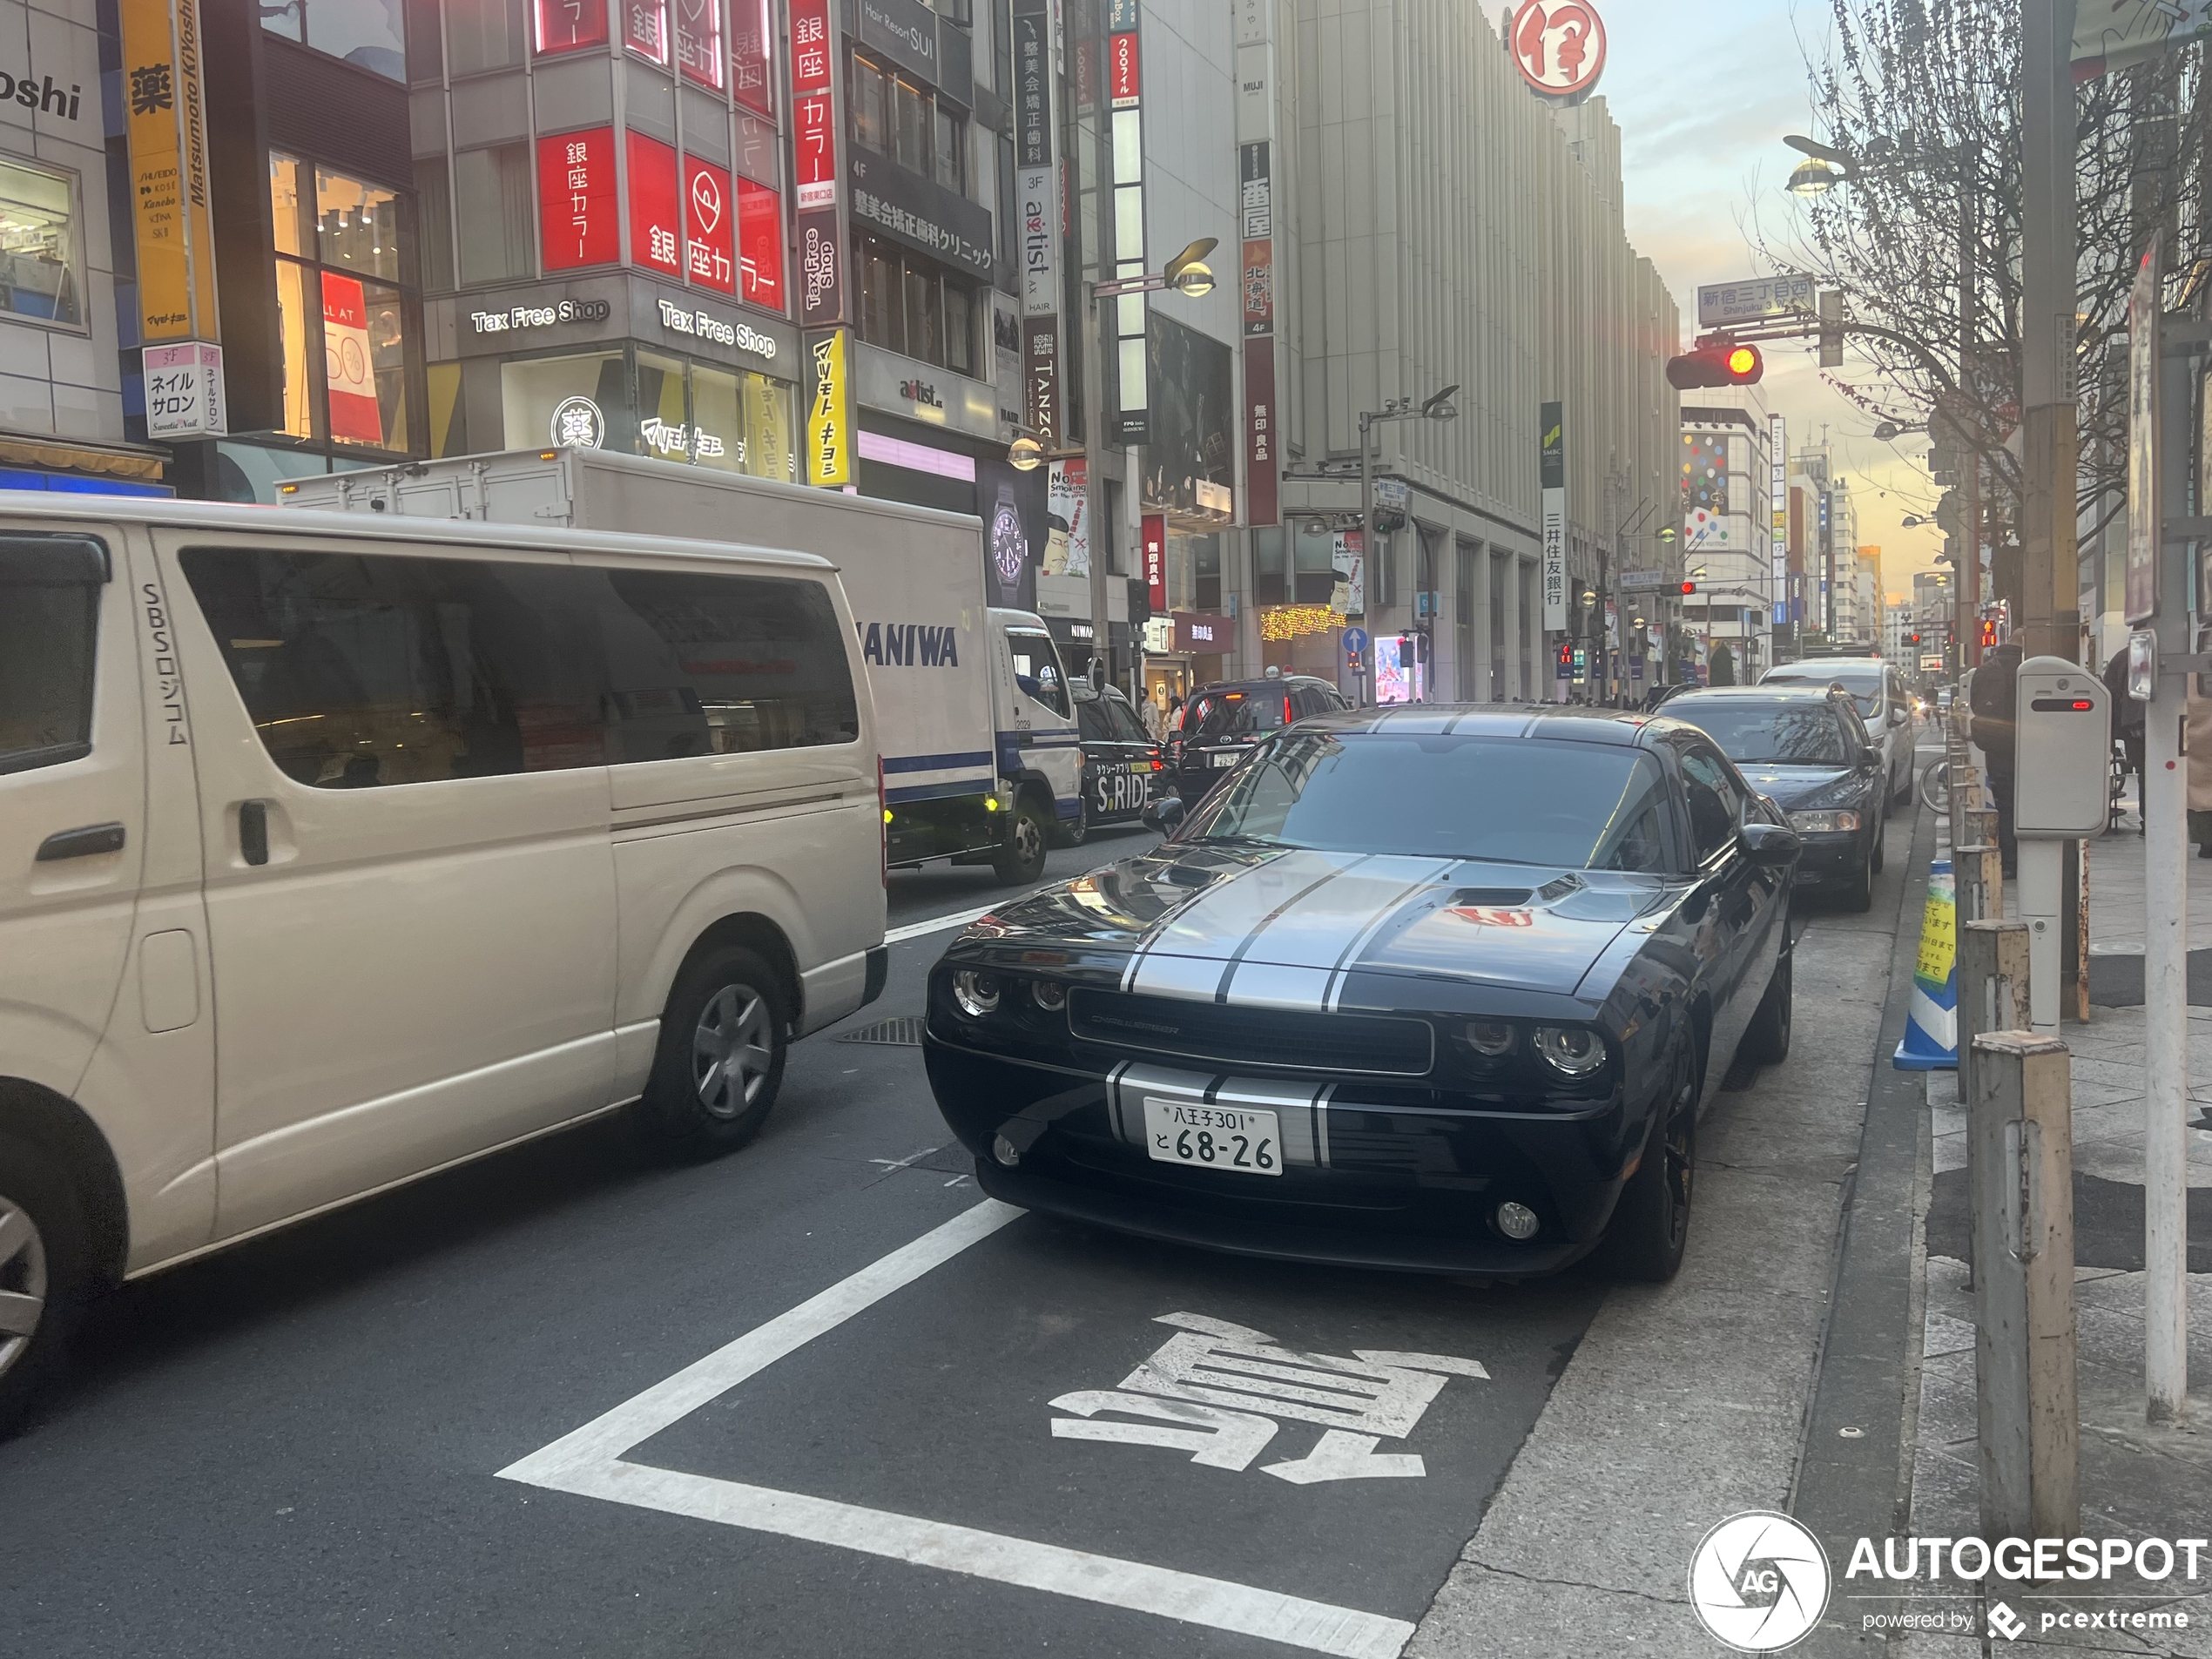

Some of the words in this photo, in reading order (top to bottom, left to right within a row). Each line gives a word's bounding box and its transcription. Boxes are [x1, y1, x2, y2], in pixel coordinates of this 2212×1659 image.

[865, 1, 882, 24] Hair
[884, 13, 909, 41] Resort
[910, 27, 933, 59] SUI
[130, 64, 173, 116] 薬
[796, 16, 824, 181] 銀座カラー
[1023, 41, 1042, 163] 整美会矯正歯科
[1244, 80, 1264, 91] MUJI
[185, 80, 206, 208] Matsumoto
[139, 167, 178, 182] SHISEIDO
[853, 159, 867, 178] 4F
[1028, 176, 1043, 189] 3F
[143, 196, 176, 209] Kanebo
[565, 141, 590, 259] 銀座カラー
[799, 188, 833, 204] 新宿東口店
[1243, 177, 1271, 237] 番屋
[853, 188, 992, 270] 整美会矯正歯科クリニック
[648, 223, 775, 293] 銀座カラー
[806, 226, 819, 273] Free
[819, 240, 834, 289] Shop
[806, 272, 821, 311] Tax
[1028, 280, 1036, 294] AX
[1246, 266, 1266, 312] 北海道
[1703, 280, 1808, 307] 新宿三丁目西
[339, 307, 354, 321] AT
[471, 310, 509, 334] Tax
[510, 303, 556, 329] Free
[557, 298, 610, 322] Shop
[1028, 301, 1050, 312] HAIR
[1723, 302, 1763, 315] Shinjuku
[1766, 300, 1772, 310] 3
[658, 298, 694, 334] Tax
[693, 308, 734, 347] Free
[735, 323, 777, 359] Shop
[1252, 323, 1265, 332] 4F
[162, 348, 179, 365] 3F
[202, 351, 217, 362] 3F
[151, 372, 194, 395] ネイル
[206, 368, 219, 427] ネイルサロン
[152, 395, 195, 416] サロン
[179, 418, 198, 429] Nail
[813, 337, 837, 477] マツモトキヨシ
[561, 406, 594, 447] 薬
[1254, 404, 1269, 462] 無印良品
[1542, 448, 1562, 456] SMBC
[1050, 484, 1087, 493] Smoking
[1051, 471, 1070, 484] No
[1335, 540, 1349, 549] No
[1546, 513, 1562, 605] 三井住友銀行
[1147, 541, 1160, 586] 無印良品
[1191, 624, 1214, 642] 無印良品
[142, 583, 188, 745] SBSロジコム
[1016, 719, 1031, 730] 2029
[1096, 763, 1130, 775] タクシーアプリ
[1097, 773, 1154, 813] S.RIDE
[1157, 1133, 1170, 1149] と
[1177, 1129, 1273, 1169] 68-26
[1047, 1311, 1492, 1485] 貨
